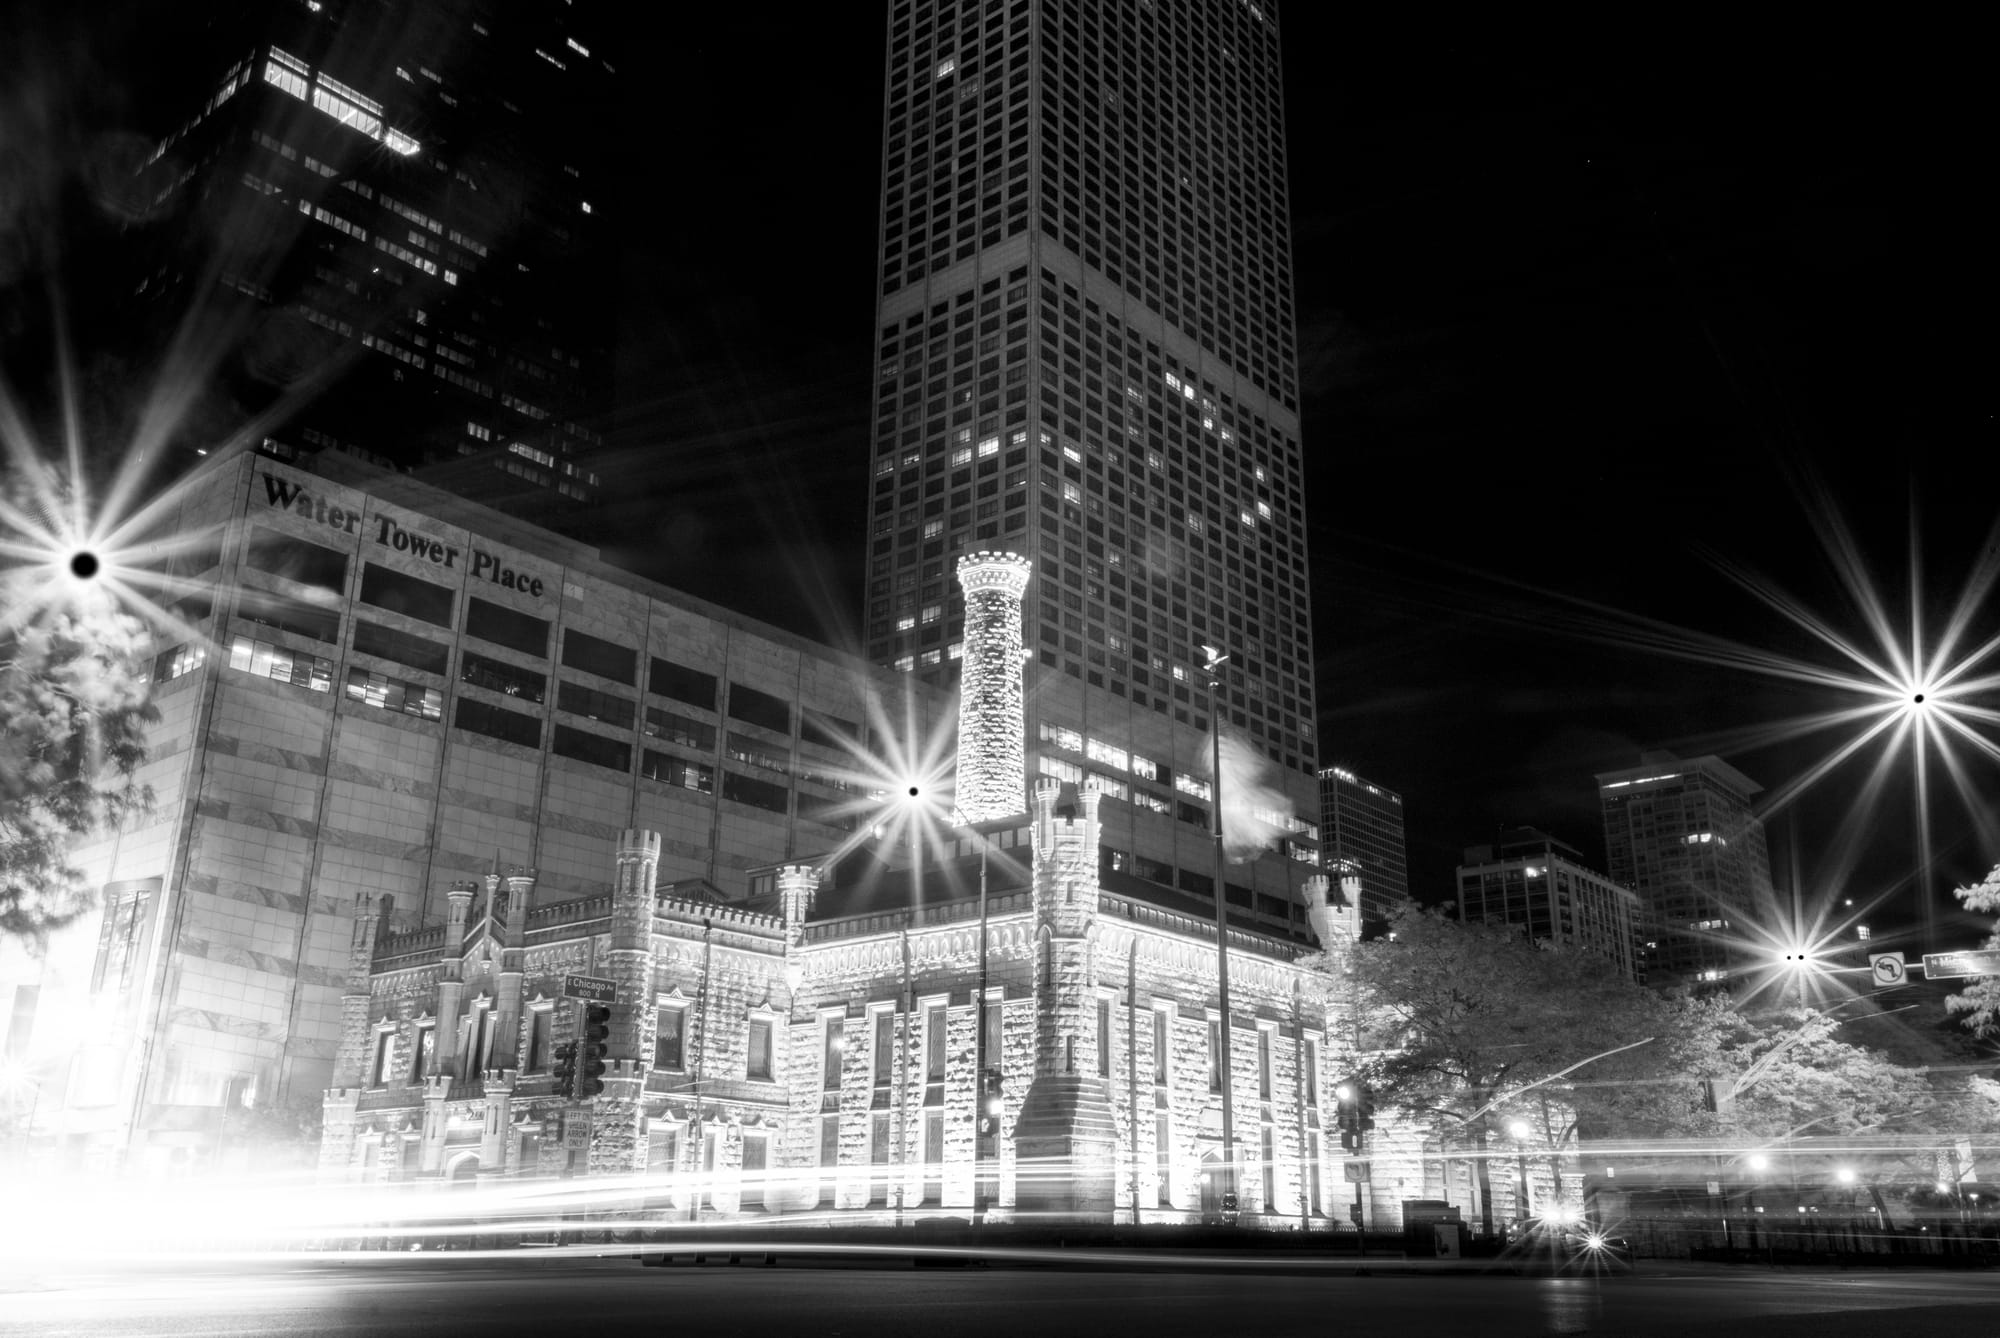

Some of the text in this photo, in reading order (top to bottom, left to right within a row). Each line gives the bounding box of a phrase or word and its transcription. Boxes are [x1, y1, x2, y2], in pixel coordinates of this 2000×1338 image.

[262, 472, 544, 597] Water Tower Place
[573, 977, 606, 991] Chicago
[566, 1111, 581, 1120] LEFT
[567, 1130, 587, 1138] ARROW
[569, 1138, 584, 1147] ONLY
